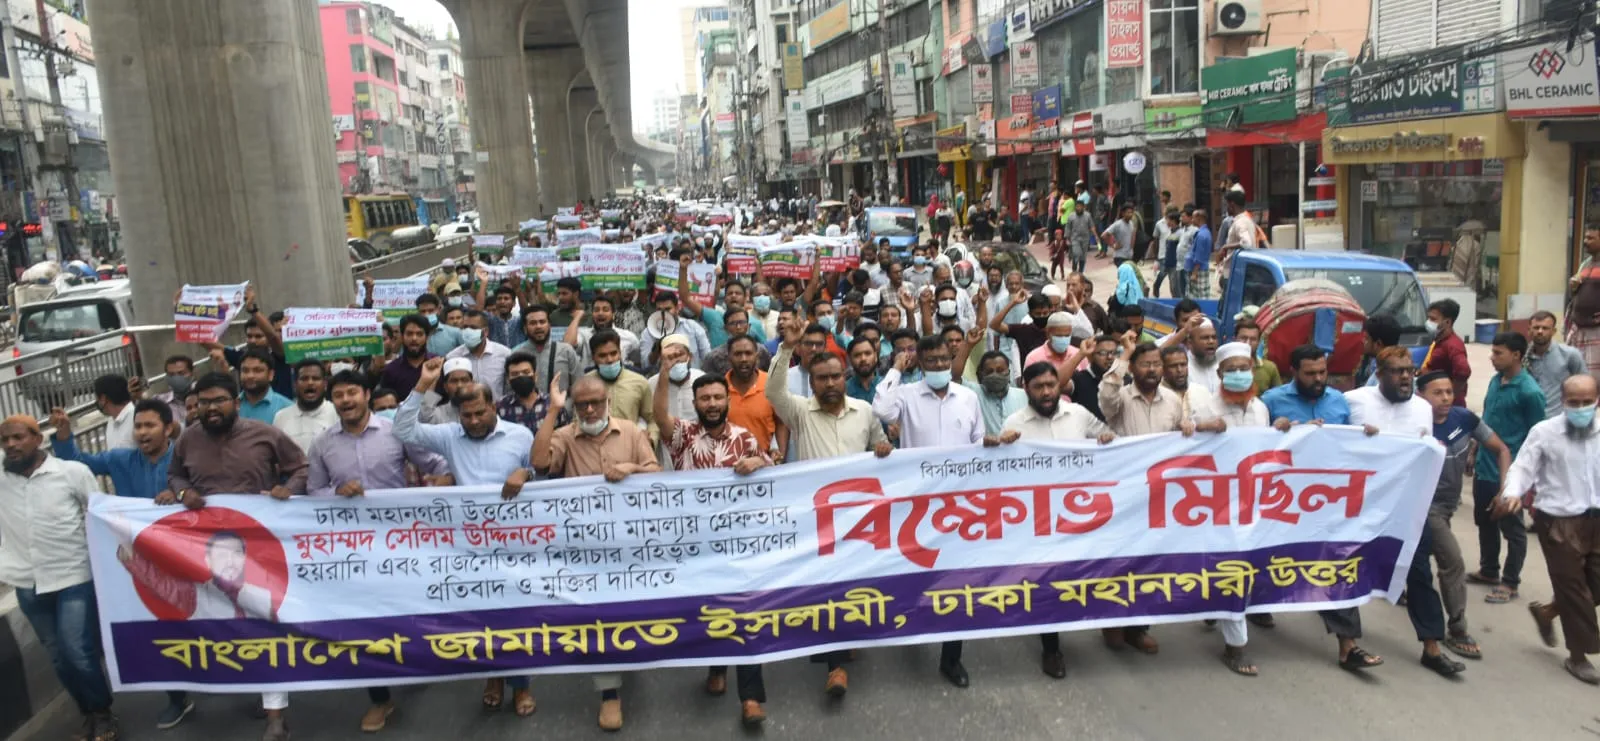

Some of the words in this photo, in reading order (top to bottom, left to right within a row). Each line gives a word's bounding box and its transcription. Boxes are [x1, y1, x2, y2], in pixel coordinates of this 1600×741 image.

[1220, 84, 1248, 99] CERAMIC
[1509, 86, 1534, 101] BHL
[1535, 83, 1594, 99] CERAMIC
[920, 457, 992, 479] বিসমিল্লাহির
[997, 452, 1053, 473] রাহমানির
[1058, 451, 1095, 468] রাহীম
[314, 507, 359, 526] ঢাকা
[366, 498, 453, 525] মহানগরী
[462, 499, 533, 523] উত্তরের
[544, 486, 615, 515] সংগ্রামী
[623, 483, 685, 510] আমীর
[692, 480, 776, 505] জননেতা
[813, 477, 1119, 569] বিক্ষোভ
[1145, 449, 1377, 528] মিছিল
[293, 529, 376, 560] মুহাম্মদ
[385, 522, 455, 550] সেলিম
[463, 521, 556, 548] উদ্দিনকে
[564, 519, 616, 542] মিথ্যা
[624, 514, 700, 538] মামলায়
[709, 505, 797, 533] গ্রেফতার,
[293, 552, 368, 581] হয়রানি
[377, 555, 421, 578] এবং
[429, 548, 537, 574] রাজনৈতিক
[545, 544, 622, 568] শিষ্টাচার
[708, 531, 799, 558] আচরণের
[426, 575, 506, 602] প্রতিবাদ
[517, 577, 532, 596] ও
[541, 567, 598, 600] মুক্তির
[606, 564, 677, 589] দাবিতে
[152, 632, 411, 672] বাংলাদেশ
[423, 617, 687, 661] জামায়াতে
[697, 587, 907, 645] ইসলামী,
[923, 580, 1040, 618] ঢাকা
[1050, 560, 1260, 608] মহানগরী
[1266, 555, 1364, 588] উত্তর
